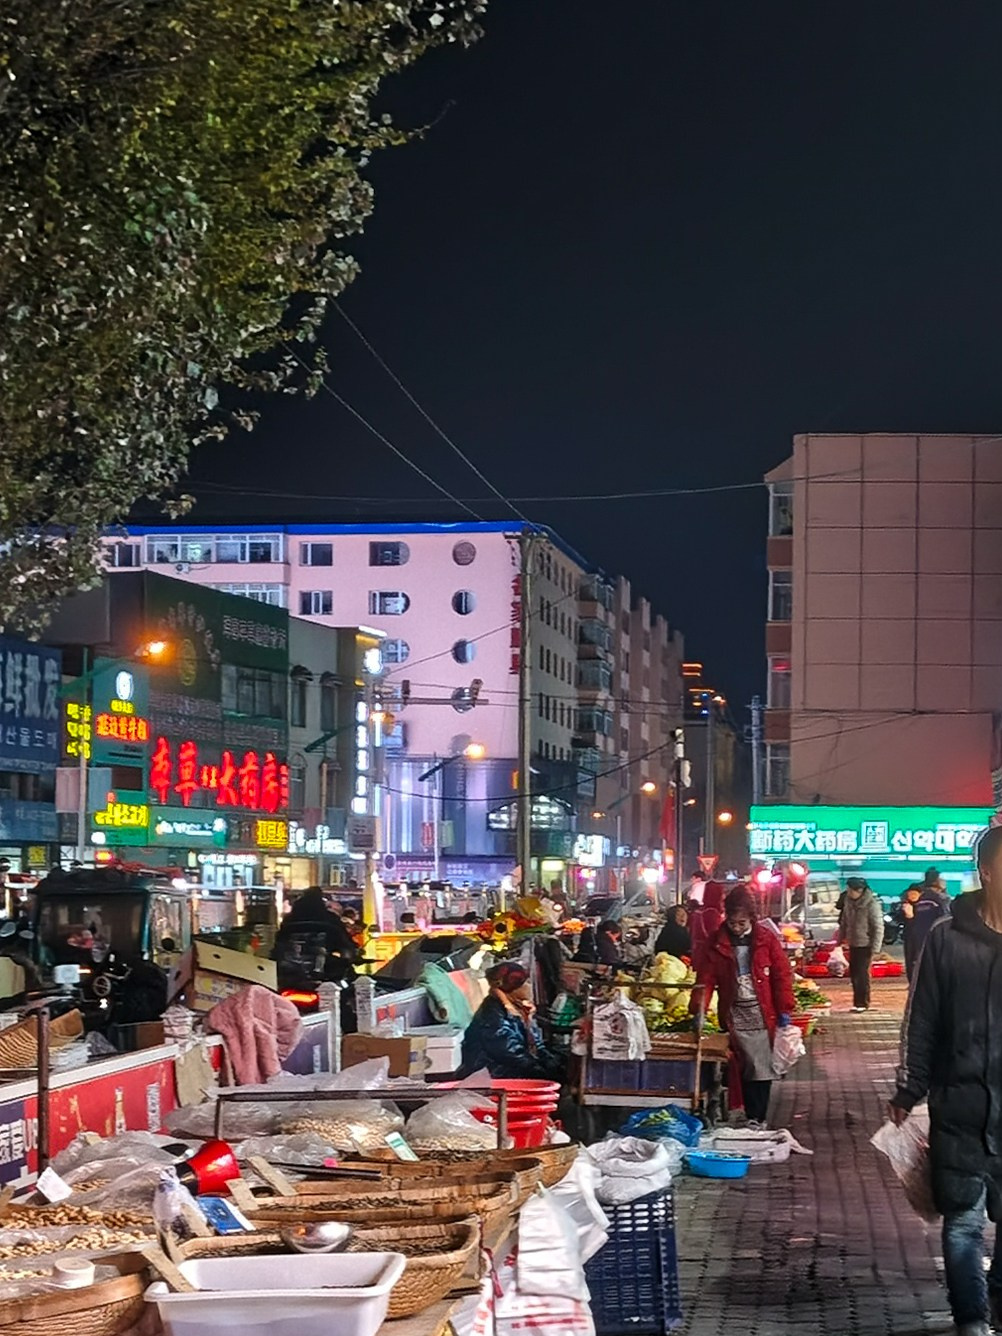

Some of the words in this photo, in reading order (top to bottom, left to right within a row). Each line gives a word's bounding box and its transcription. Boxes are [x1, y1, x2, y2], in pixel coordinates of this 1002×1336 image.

[751, 829, 858, 853] 新药大药房
